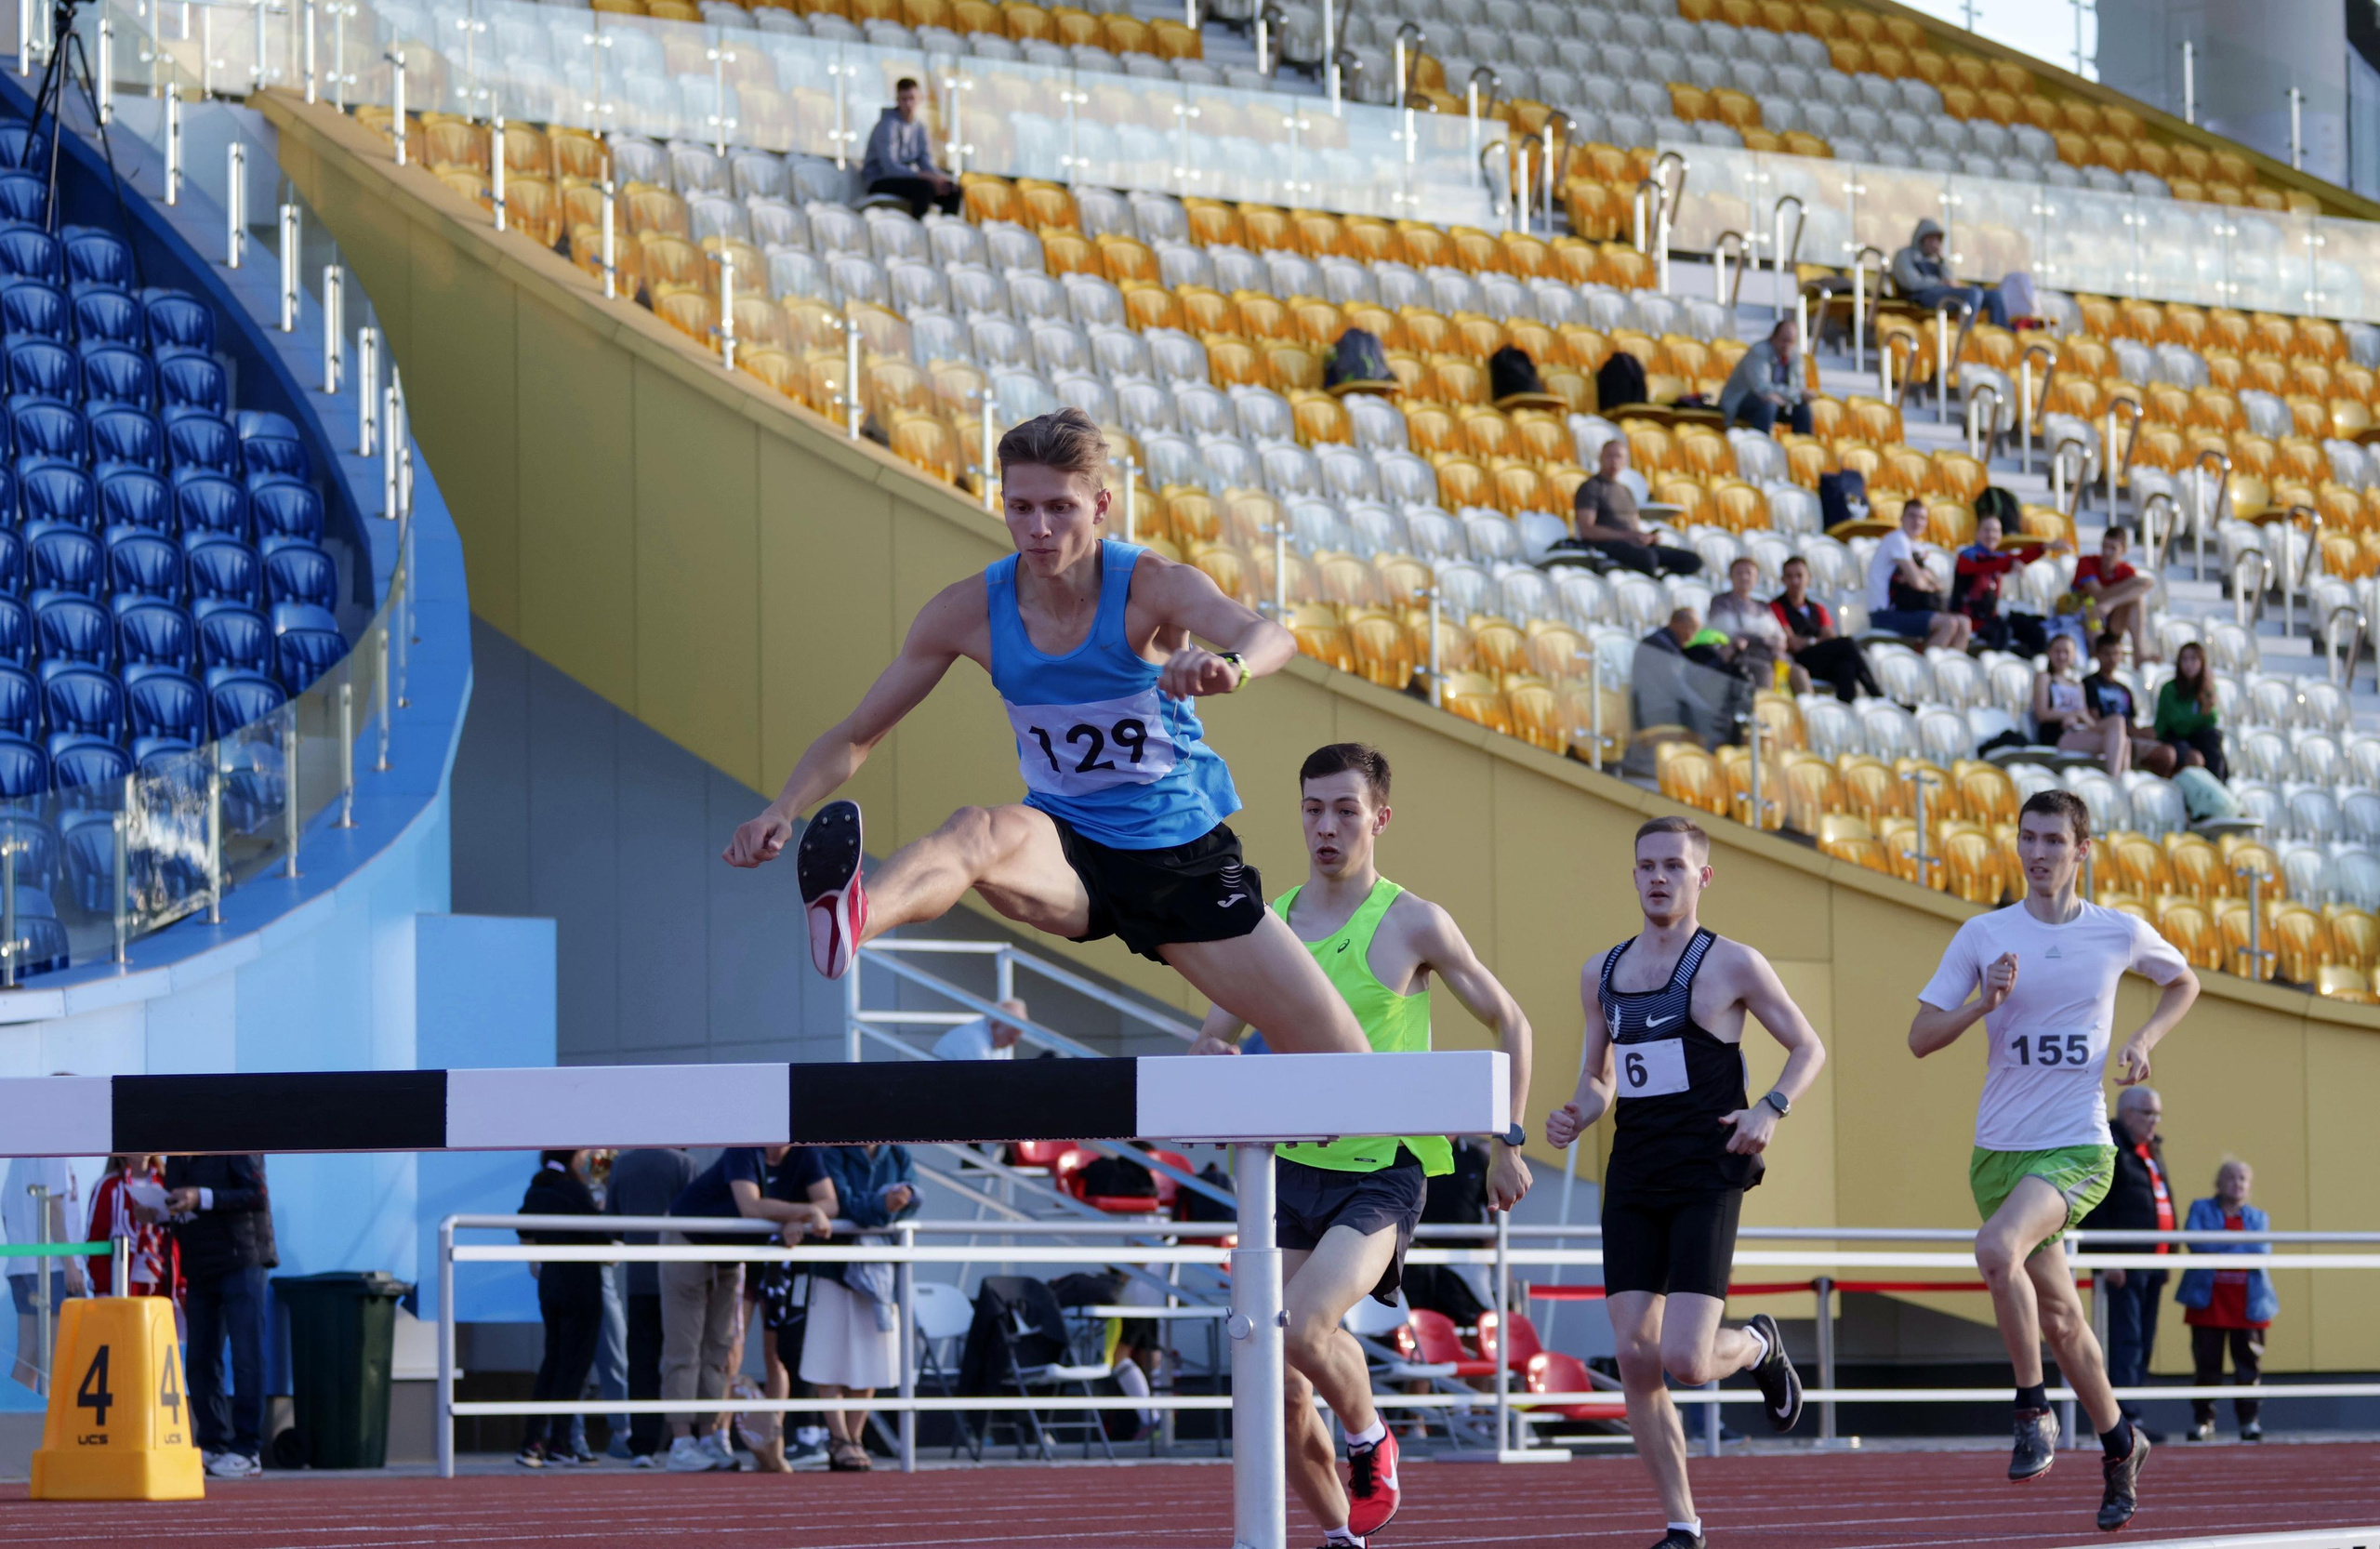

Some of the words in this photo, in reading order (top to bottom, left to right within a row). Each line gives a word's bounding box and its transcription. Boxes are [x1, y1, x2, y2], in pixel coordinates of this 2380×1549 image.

[1028, 719, 1148, 774] 129
[1625, 1053, 1648, 1088] 6
[2011, 1034, 2090, 1066] 155
[77, 1344, 113, 1426] 4
[160, 1344, 180, 1425] 4
[77, 1434, 109, 1445] UCS
